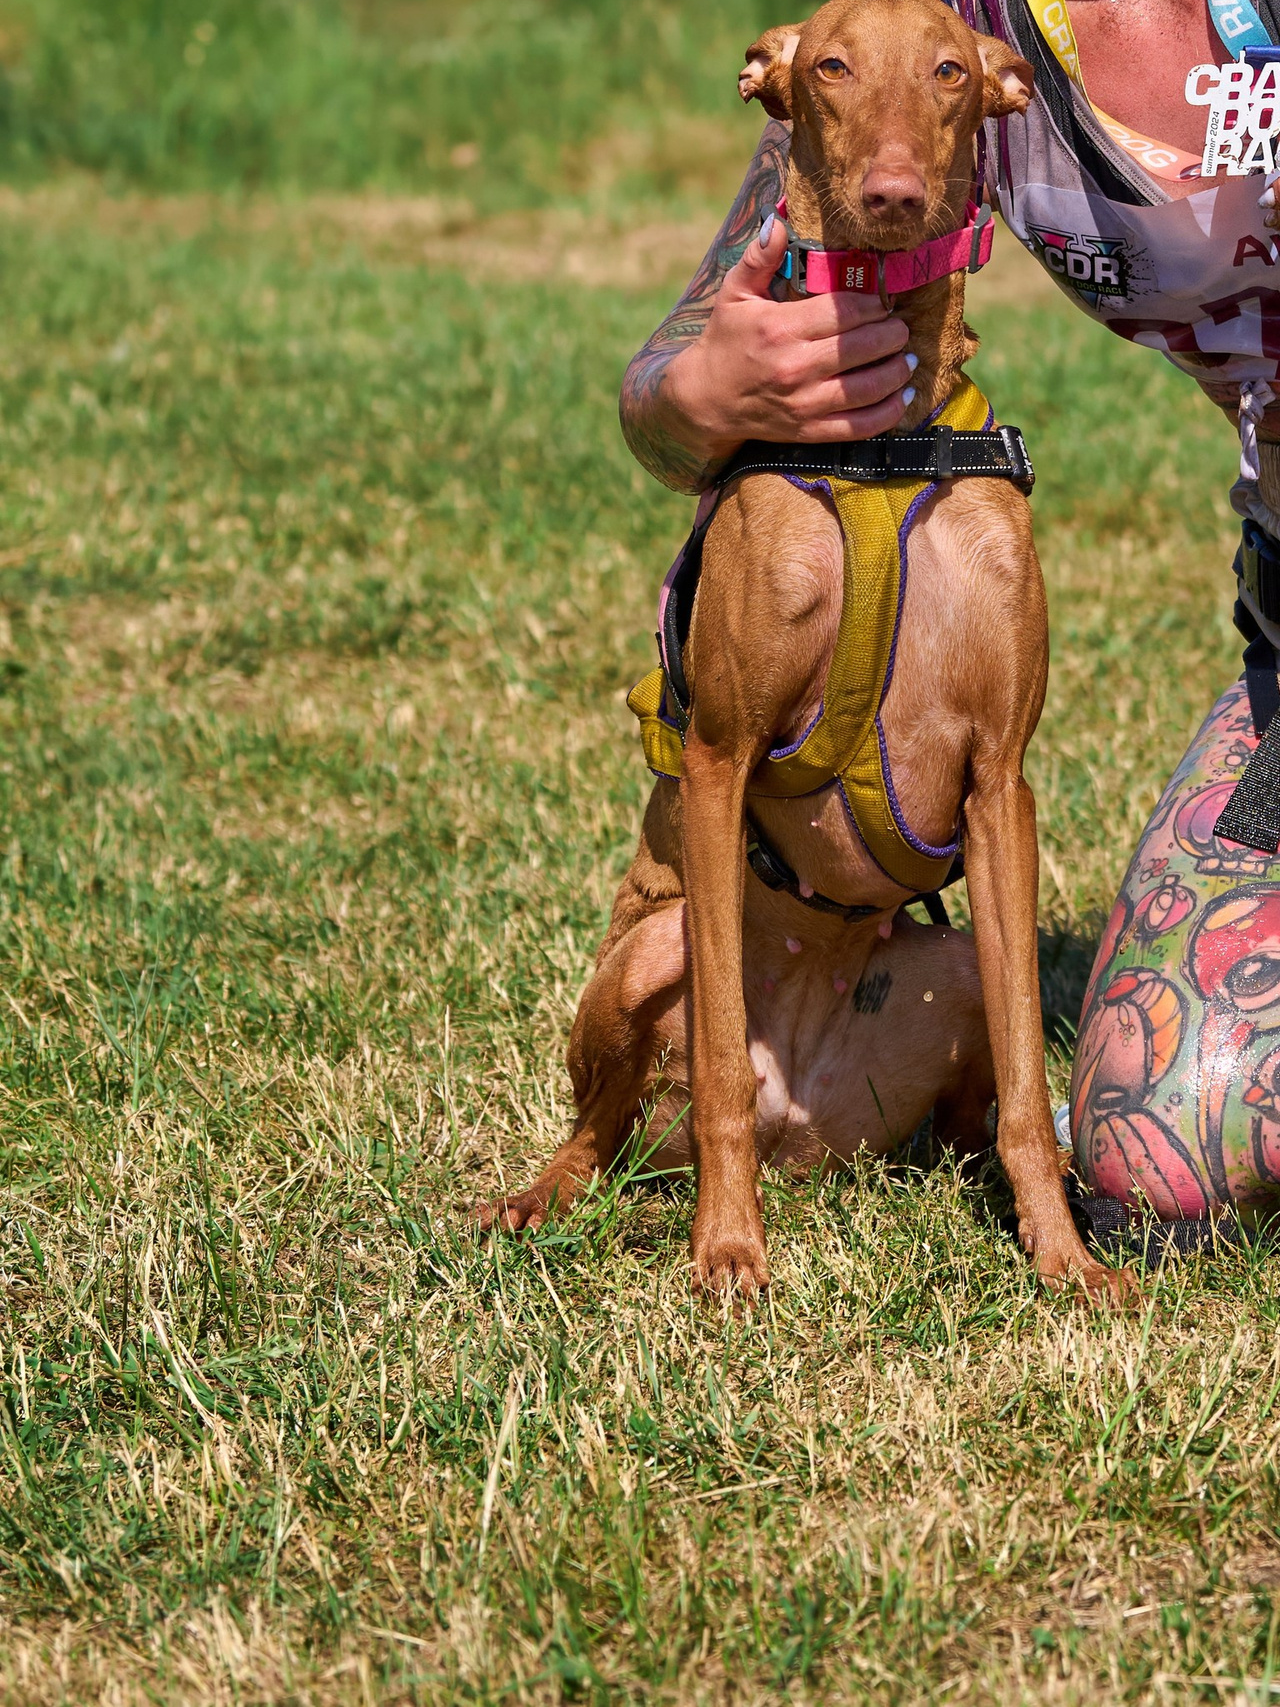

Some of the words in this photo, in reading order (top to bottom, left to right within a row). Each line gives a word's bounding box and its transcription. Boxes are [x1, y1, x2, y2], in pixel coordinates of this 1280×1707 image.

[1043, 0, 1076, 74] CRA
[1209, 111, 1220, 137] 2024
[845, 267, 854, 287] DOG
[855, 267, 864, 288] WAU
[1044, 246, 1120, 285] CDR
